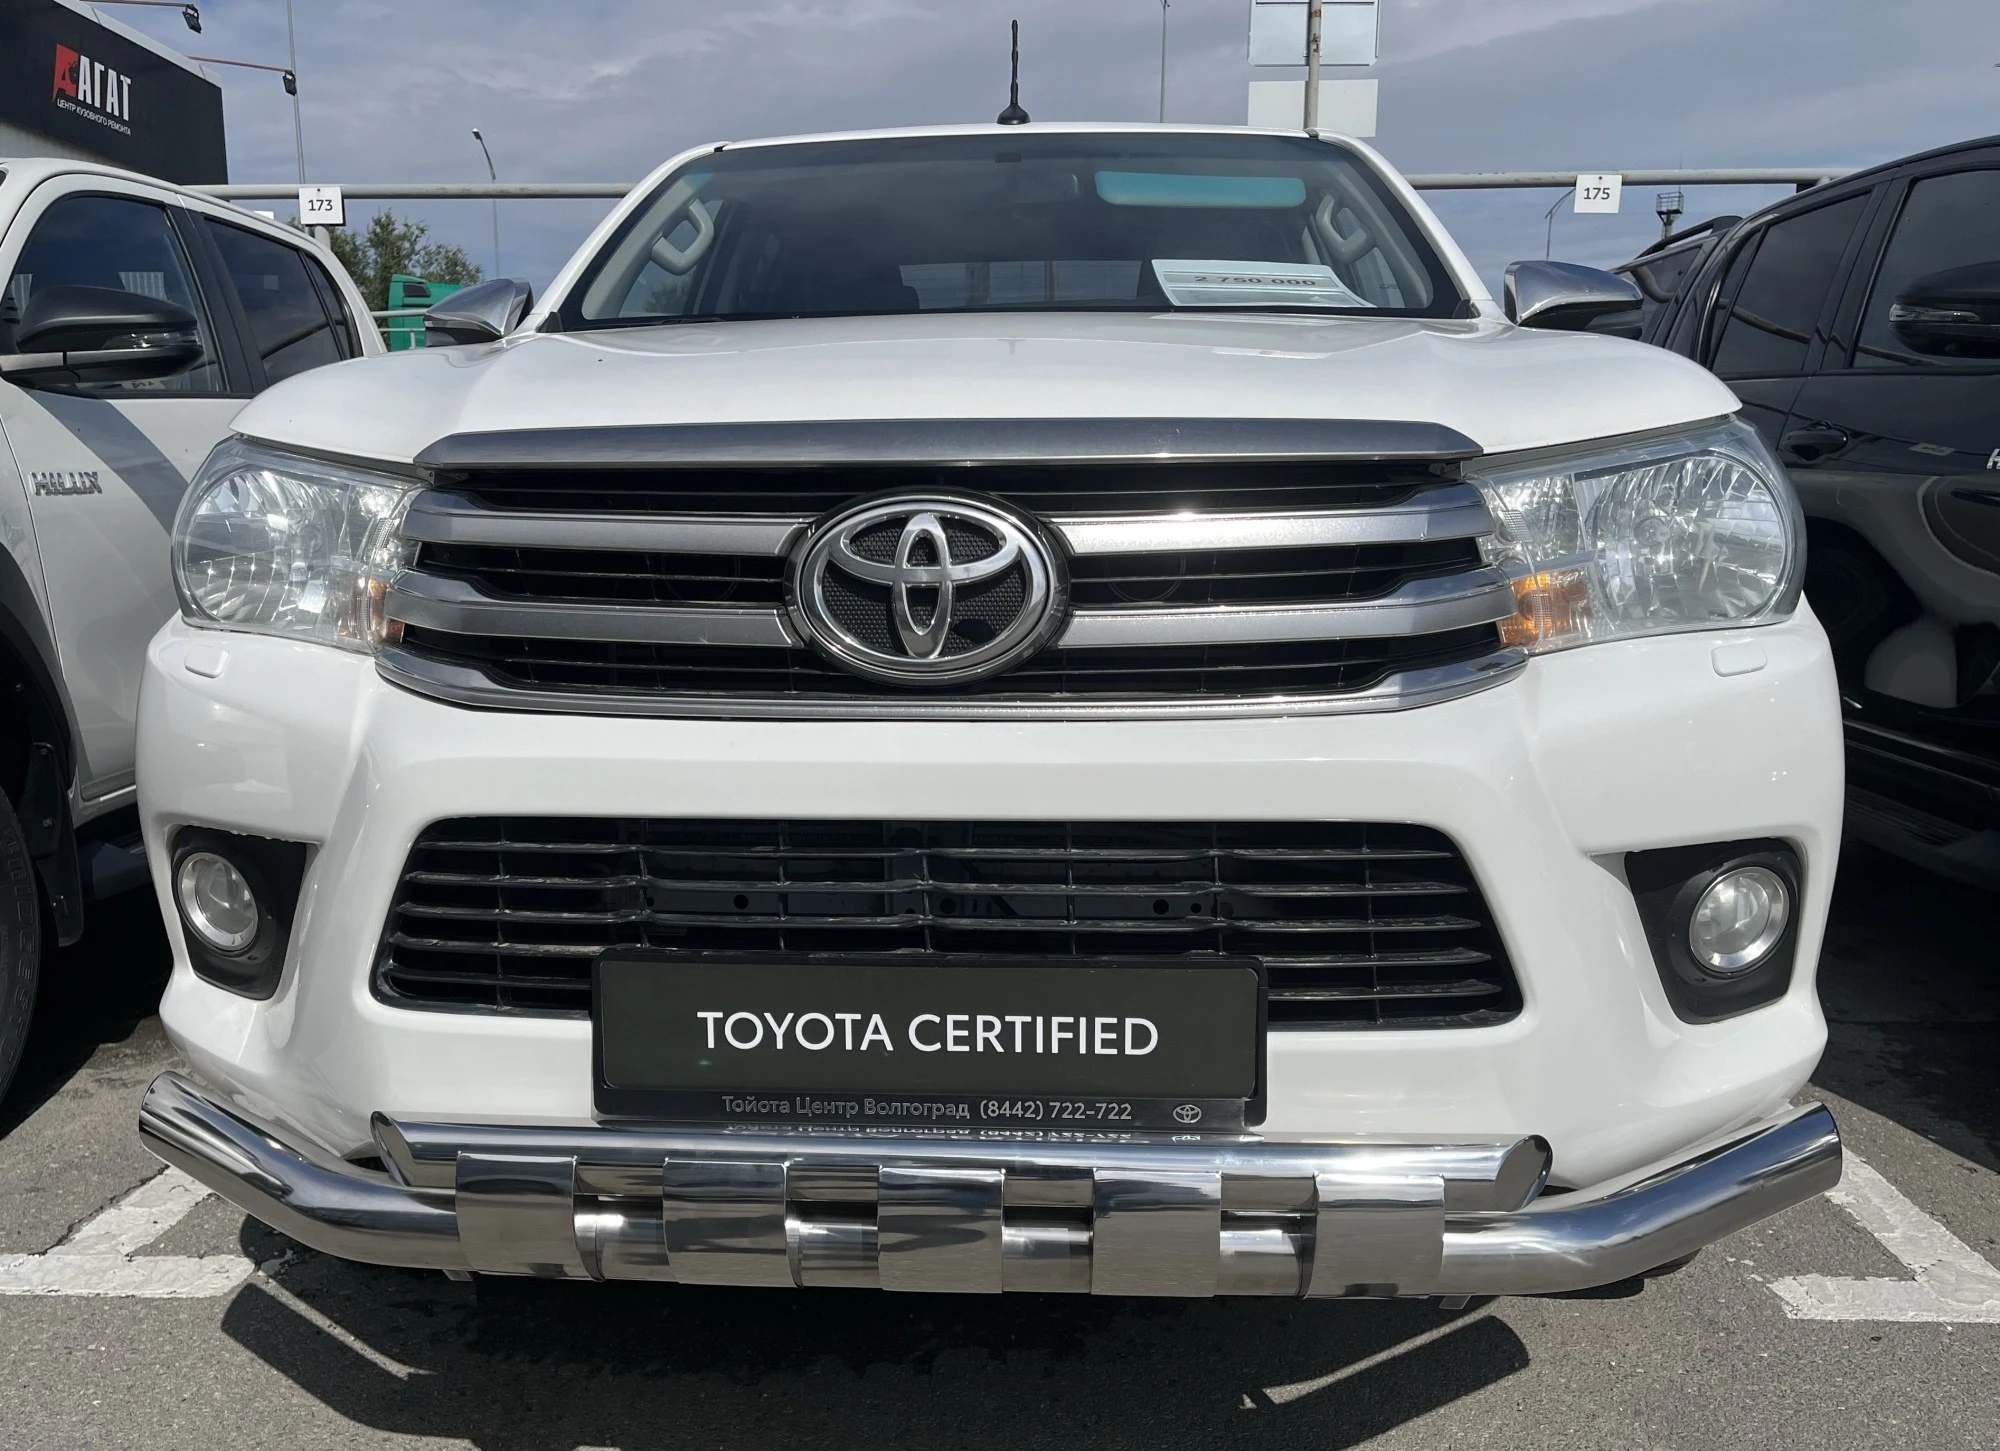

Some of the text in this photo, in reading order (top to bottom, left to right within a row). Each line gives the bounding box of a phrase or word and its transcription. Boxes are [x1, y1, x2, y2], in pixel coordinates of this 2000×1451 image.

[57, 98, 131, 136] ЦЕНТР КУЗОВНОГО РЕМОНТА
[308, 199, 333, 212] 173
[1584, 187, 1610, 200] 175
[1219, 276, 1262, 284] 750
[1271, 278, 1317, 286] 000
[28, 471, 103, 496] HILUX
[697, 1011, 1159, 1056] TOYOTA CERTIFIED
[722, 1096, 1132, 1121] Тойота Центр Волгоград (8442) 722-722
